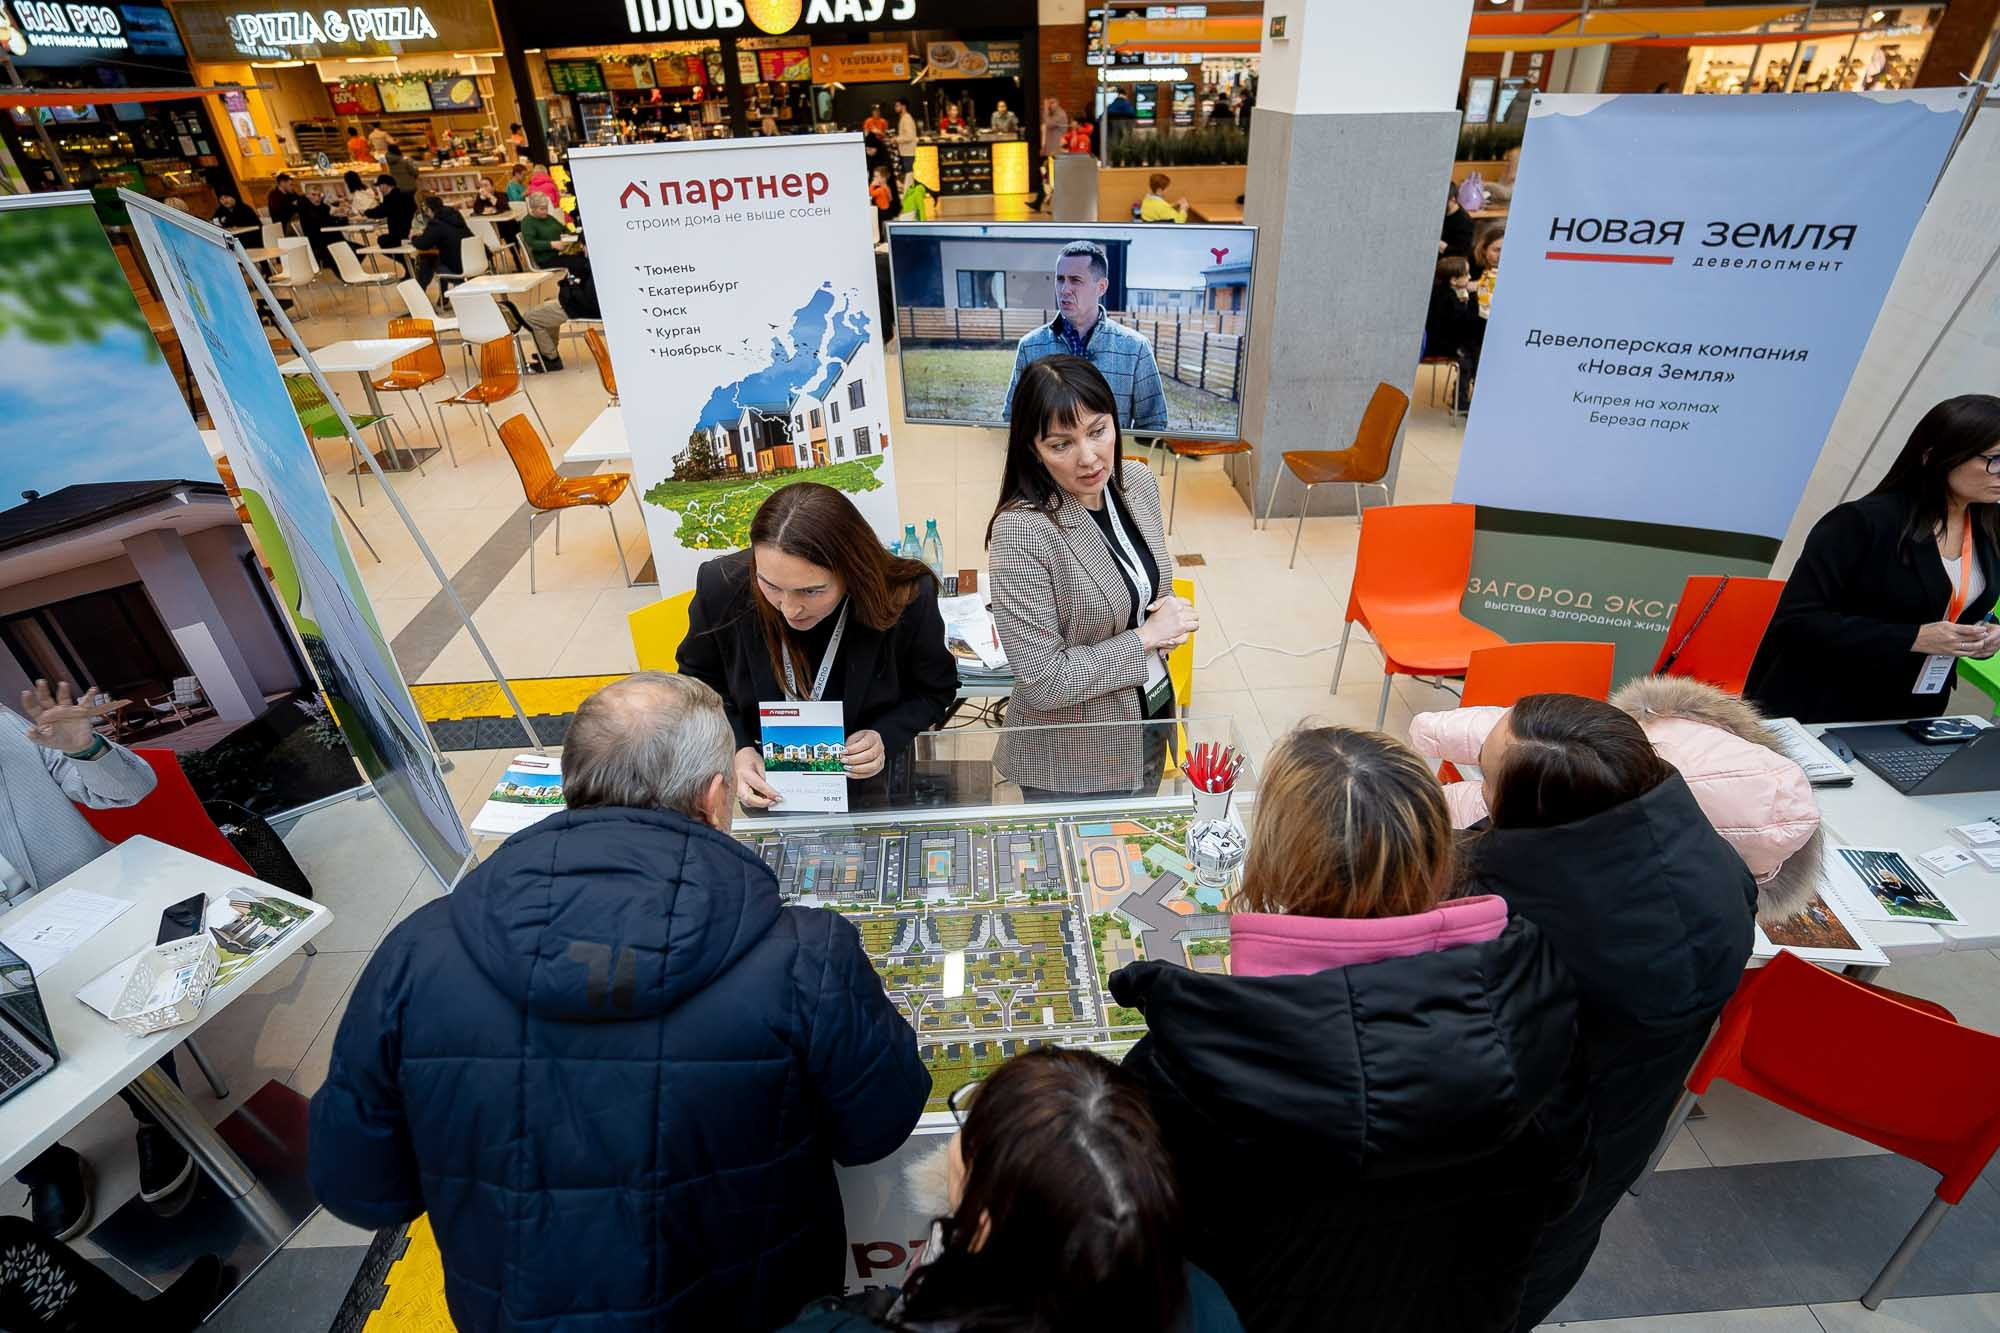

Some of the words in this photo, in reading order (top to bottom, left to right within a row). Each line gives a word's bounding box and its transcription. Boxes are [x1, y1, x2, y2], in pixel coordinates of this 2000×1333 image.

[14, 1, 70, 32] HAI
[66, 4, 121, 35] PHO
[236, 12, 327, 46] PIZZA
[323, 10, 350, 42] &
[348, 7, 438, 41] PIZZA
[659, 171, 829, 210] партнер
[626, 217, 681, 231] строим
[685, 214, 721, 228] дома
[725, 212, 743, 224] не
[746, 209, 786, 222] выше
[789, 207, 832, 219] сосен
[1549, 217, 1686, 245] новая
[1701, 221, 1858, 251] земля
[643, 263, 696, 276] Тюмень
[1692, 256, 1844, 272] девелопмент
[648, 280, 740, 297] Екатеринбург
[652, 306, 687, 318] Омск
[656, 326, 701, 338] Курган
[660, 343, 722, 358] Ноябрьск
[1525, 329, 1693, 356] Девелоперская
[1698, 343, 1809, 362] компания
[1577, 359, 1652, 379] «Новая
[1658, 363, 1736, 384] Земля»
[1572, 391, 1631, 410] Кипрея
[1634, 397, 1656, 409] на
[1659, 399, 1721, 415] холмах
[1589, 411, 1647, 429] Береза
[1650, 416, 1691, 432] парк
[1467, 577, 1593, 609] ЗАГОРОД
[1604, 596, 1680, 620] ЭКСП
[1484, 600, 1547, 617] выставка
[1549, 609, 1632, 629] загородной
[1634, 620, 1672, 633] жизн
